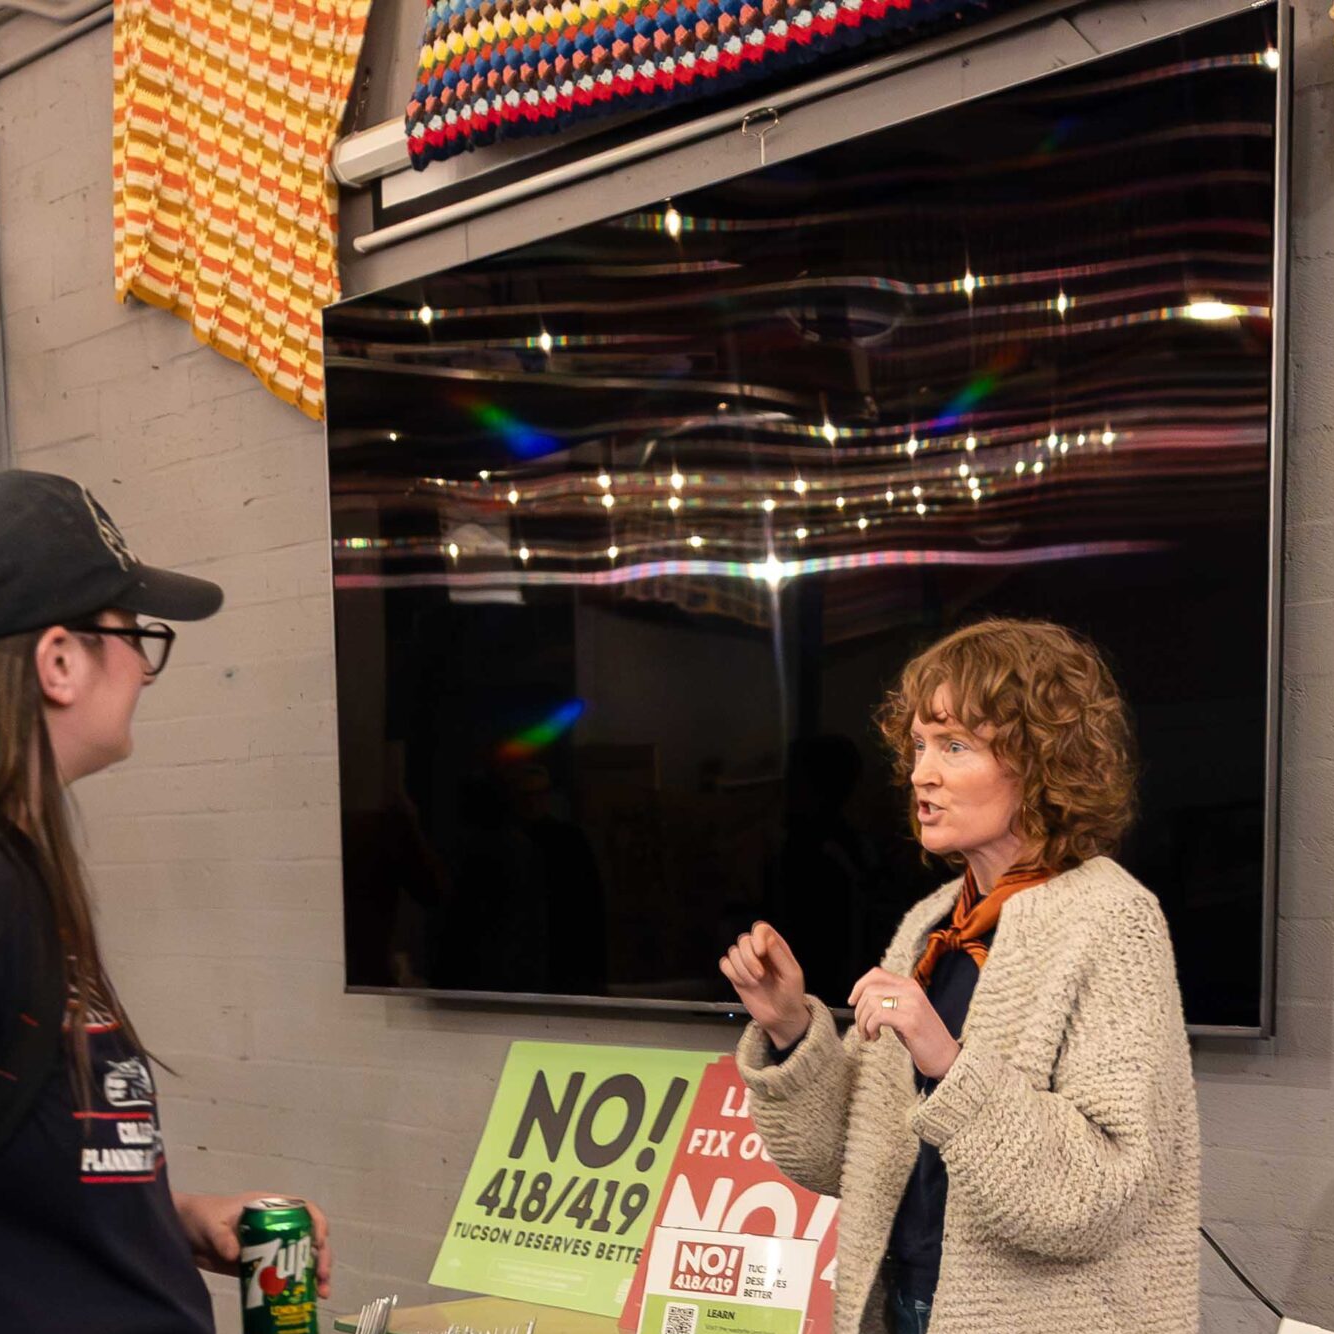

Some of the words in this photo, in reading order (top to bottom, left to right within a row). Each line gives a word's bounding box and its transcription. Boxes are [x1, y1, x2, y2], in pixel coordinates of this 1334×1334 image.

[508, 1070, 689, 1172] NO!
[686, 1128, 733, 1160] FIX
[475, 1167, 651, 1236] 418/419
[453, 1221, 510, 1245] TUCSON
[514, 1231, 592, 1259] DESERVES
[596, 1243, 644, 1265] BETTE
[677, 1243, 740, 1277] NO!
[673, 1273, 734, 1293] 418/419
[743, 1288, 773, 1300] BETTER
[706, 1308, 736, 1321] LEARN
